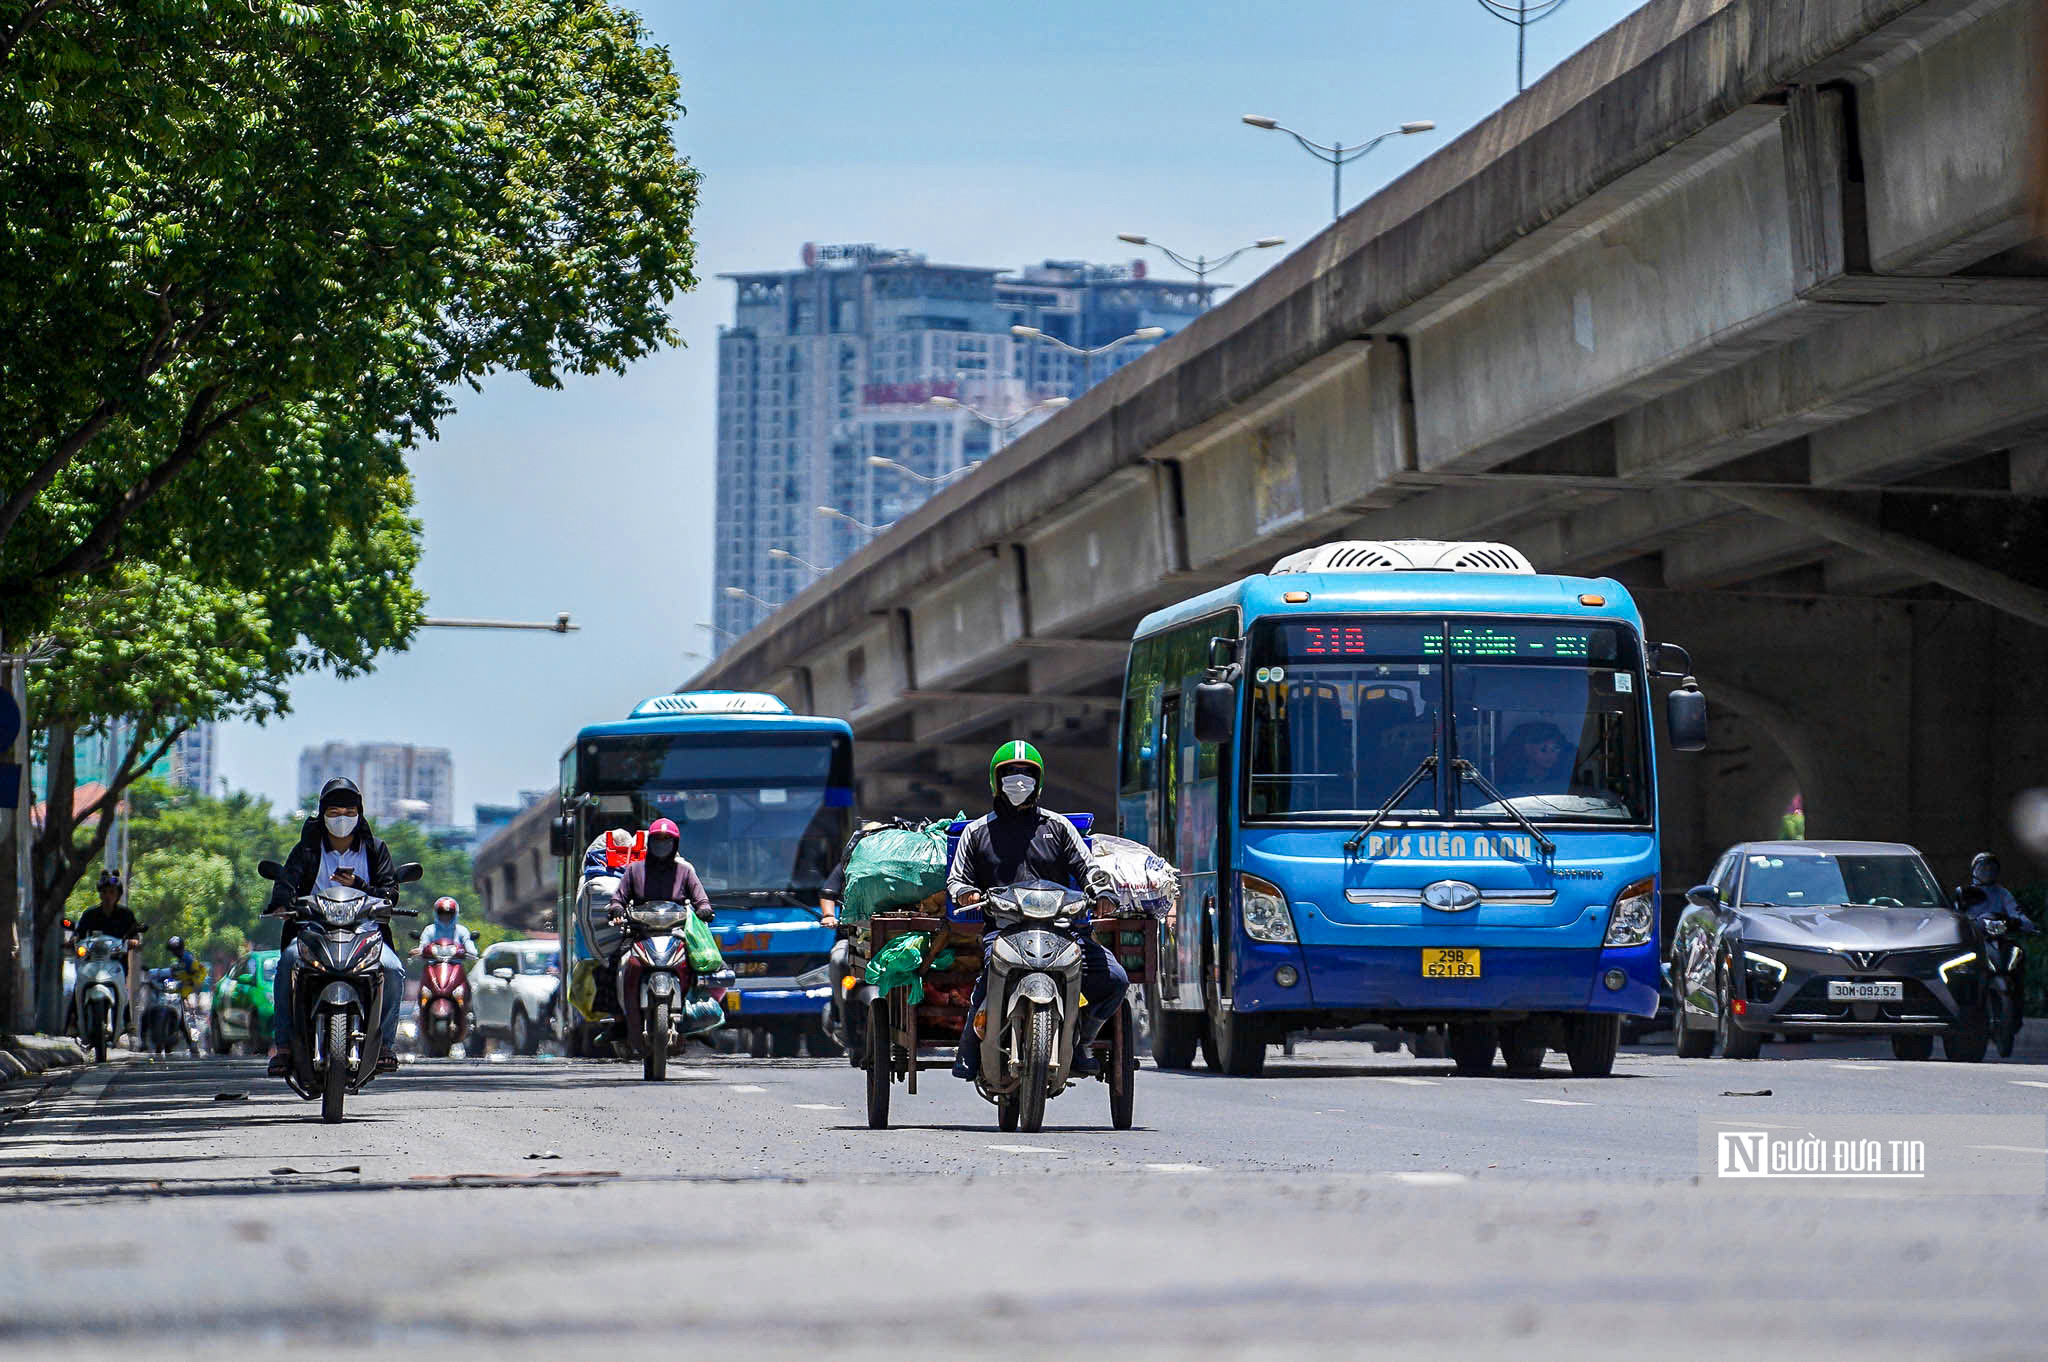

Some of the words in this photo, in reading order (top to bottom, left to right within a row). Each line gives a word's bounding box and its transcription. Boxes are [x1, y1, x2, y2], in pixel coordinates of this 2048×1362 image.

[1369, 836, 1411, 857] BUS
[1419, 831, 1466, 857] LIÊN
[1474, 836, 1531, 857] NINH
[1439, 950, 1464, 962] 29B
[1428, 963, 1474, 976] 621.83
